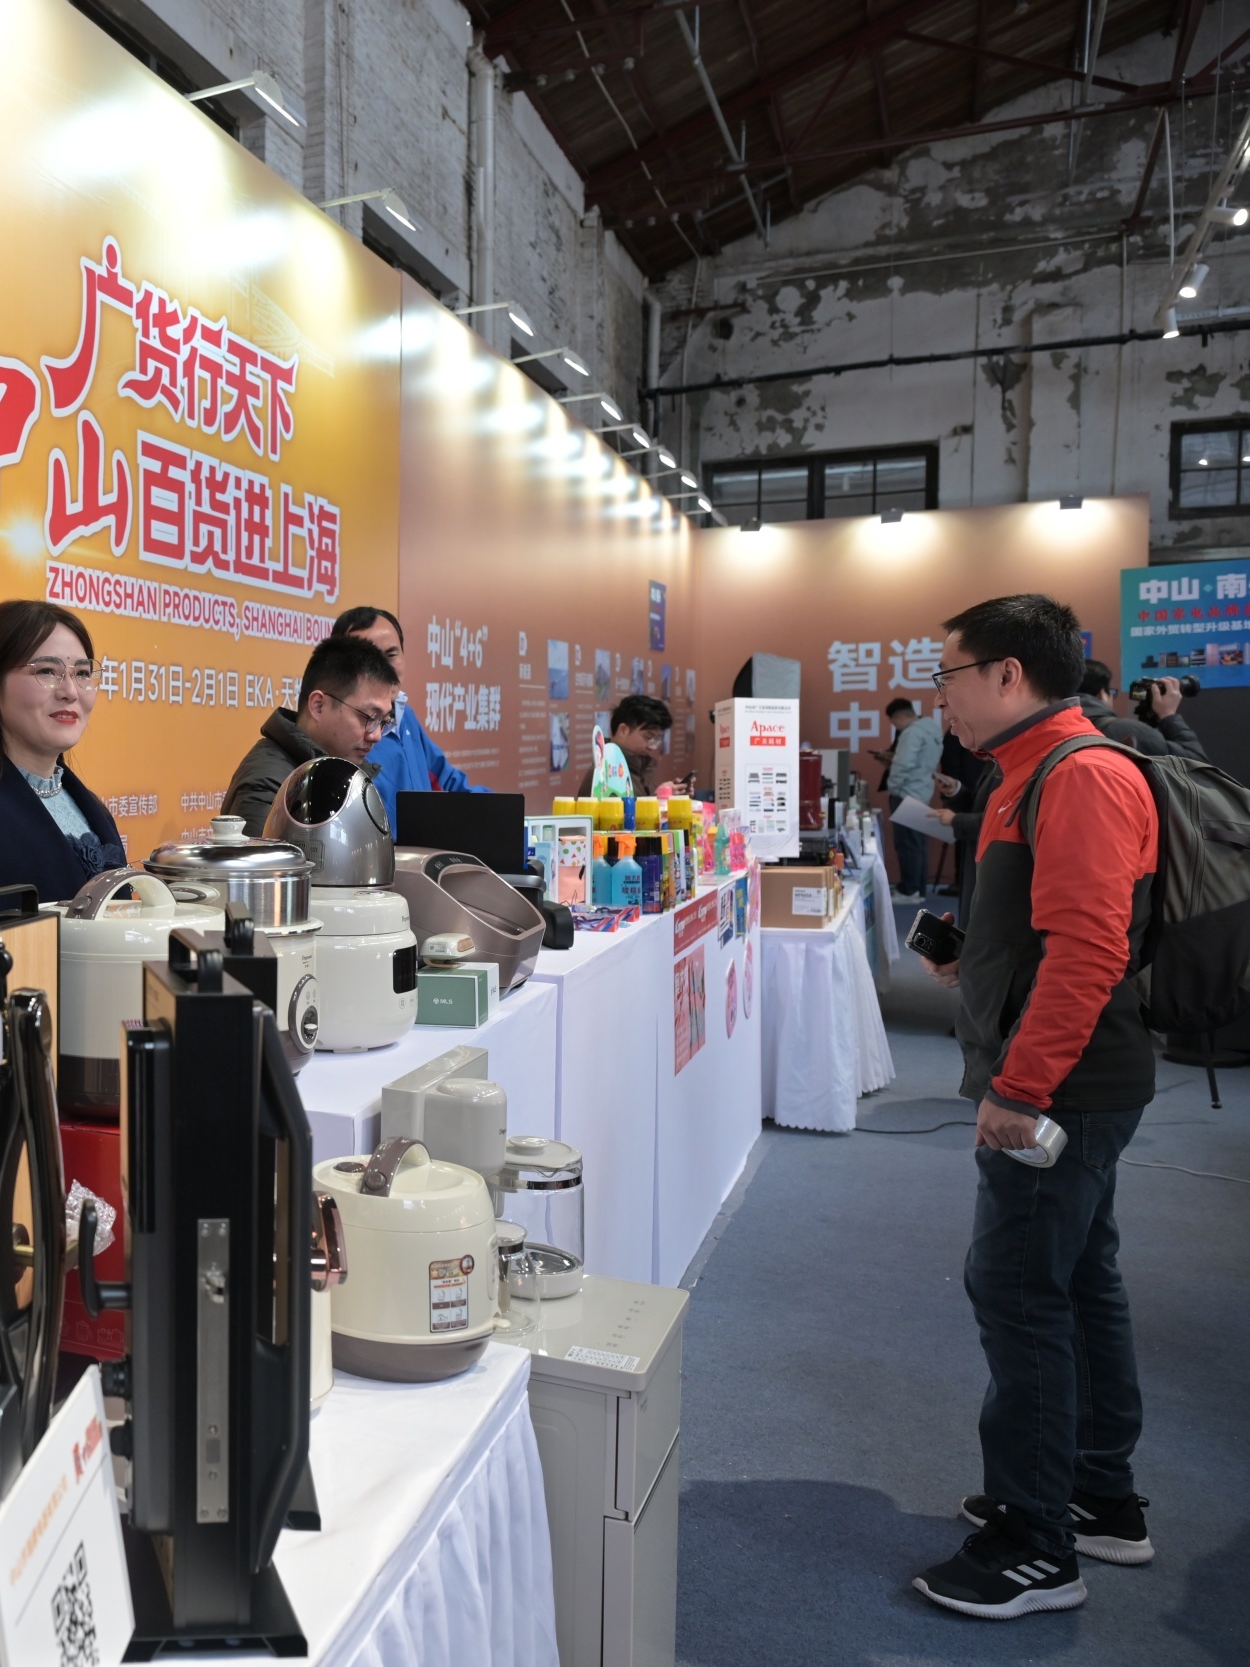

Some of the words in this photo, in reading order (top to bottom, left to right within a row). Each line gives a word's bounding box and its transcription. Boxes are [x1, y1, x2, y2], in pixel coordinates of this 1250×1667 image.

[41, 236, 299, 461] 广货行天下
[47, 566, 158, 616] ZHONGSHAN
[162, 589, 241, 640] PRODUCTS,
[243, 604, 303, 638] SHANGHAI
[425, 682, 501, 733] 现代产业集群
[750, 720, 786, 737] Apace
